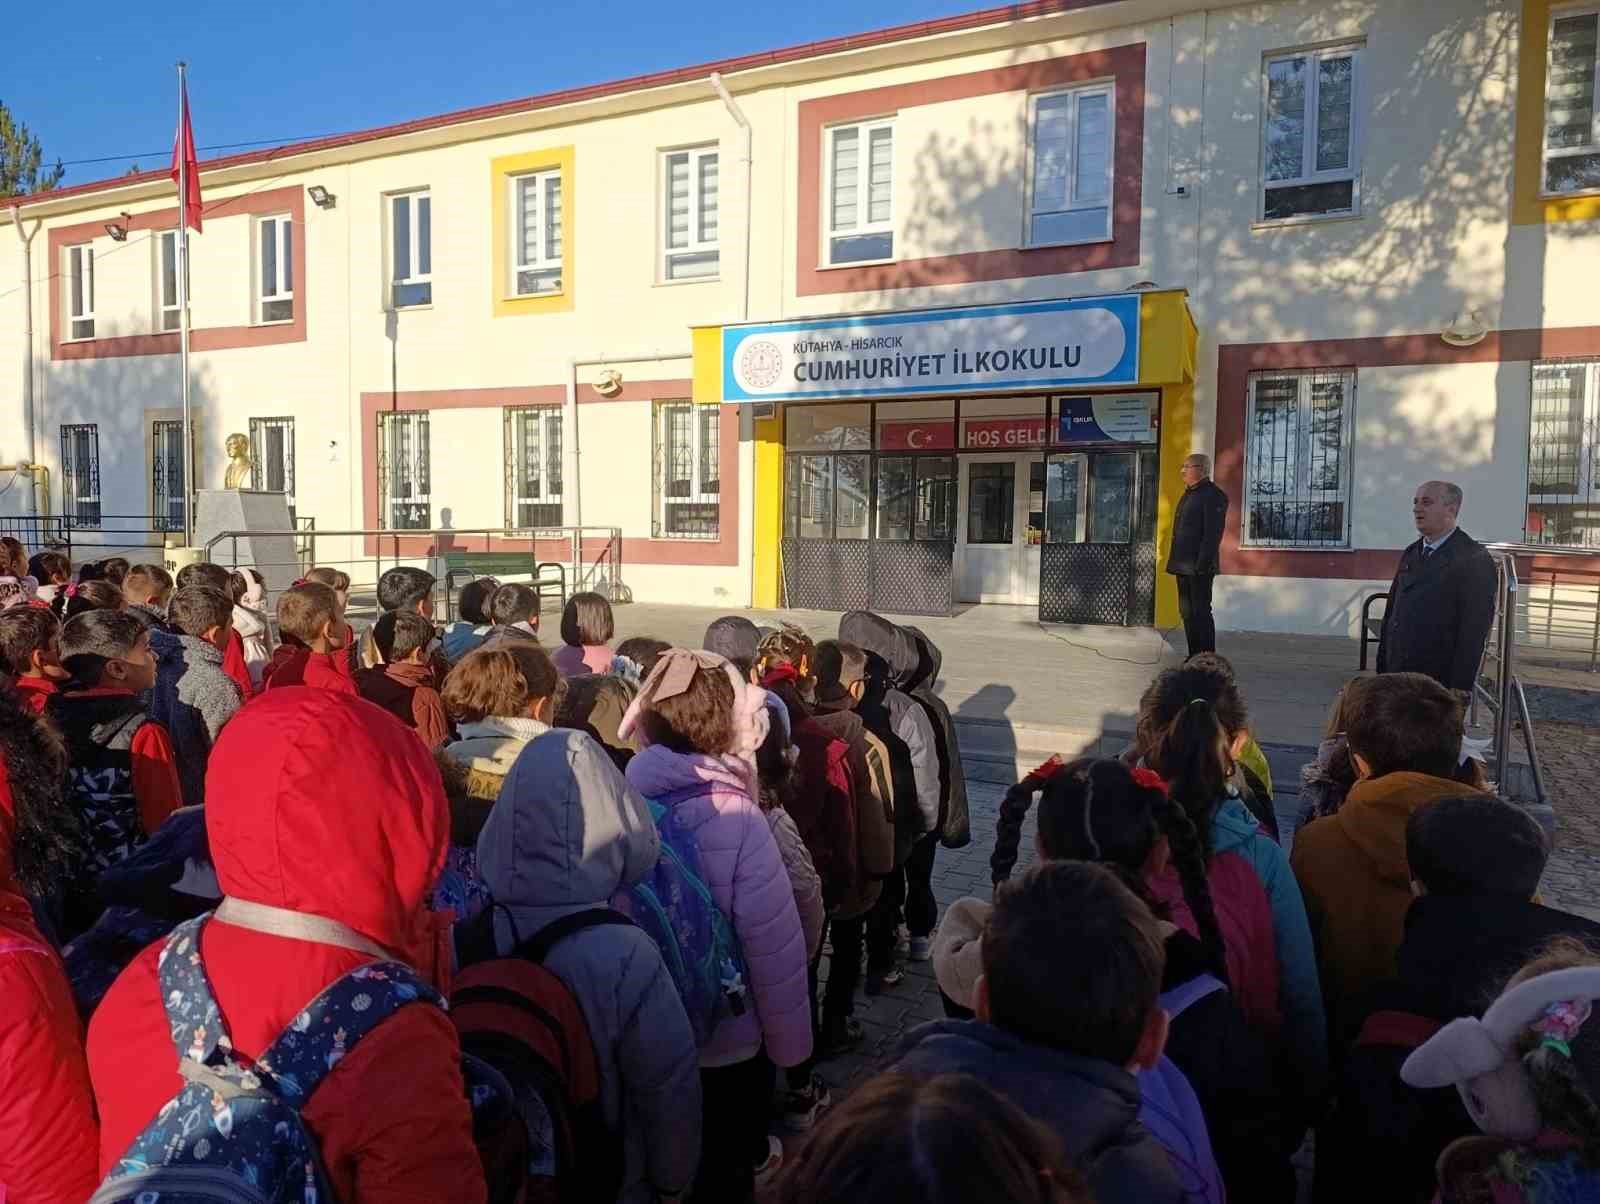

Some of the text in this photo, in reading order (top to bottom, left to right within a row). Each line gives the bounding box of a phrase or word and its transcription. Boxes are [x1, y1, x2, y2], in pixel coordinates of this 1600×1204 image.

[793, 339, 843, 354] KÜTAHYA
[851, 336, 904, 350] HİSARCIK
[793, 345, 1081, 382] CUMHURİYET İLKOKULU
[967, 430, 1001, 448] HOŞ
